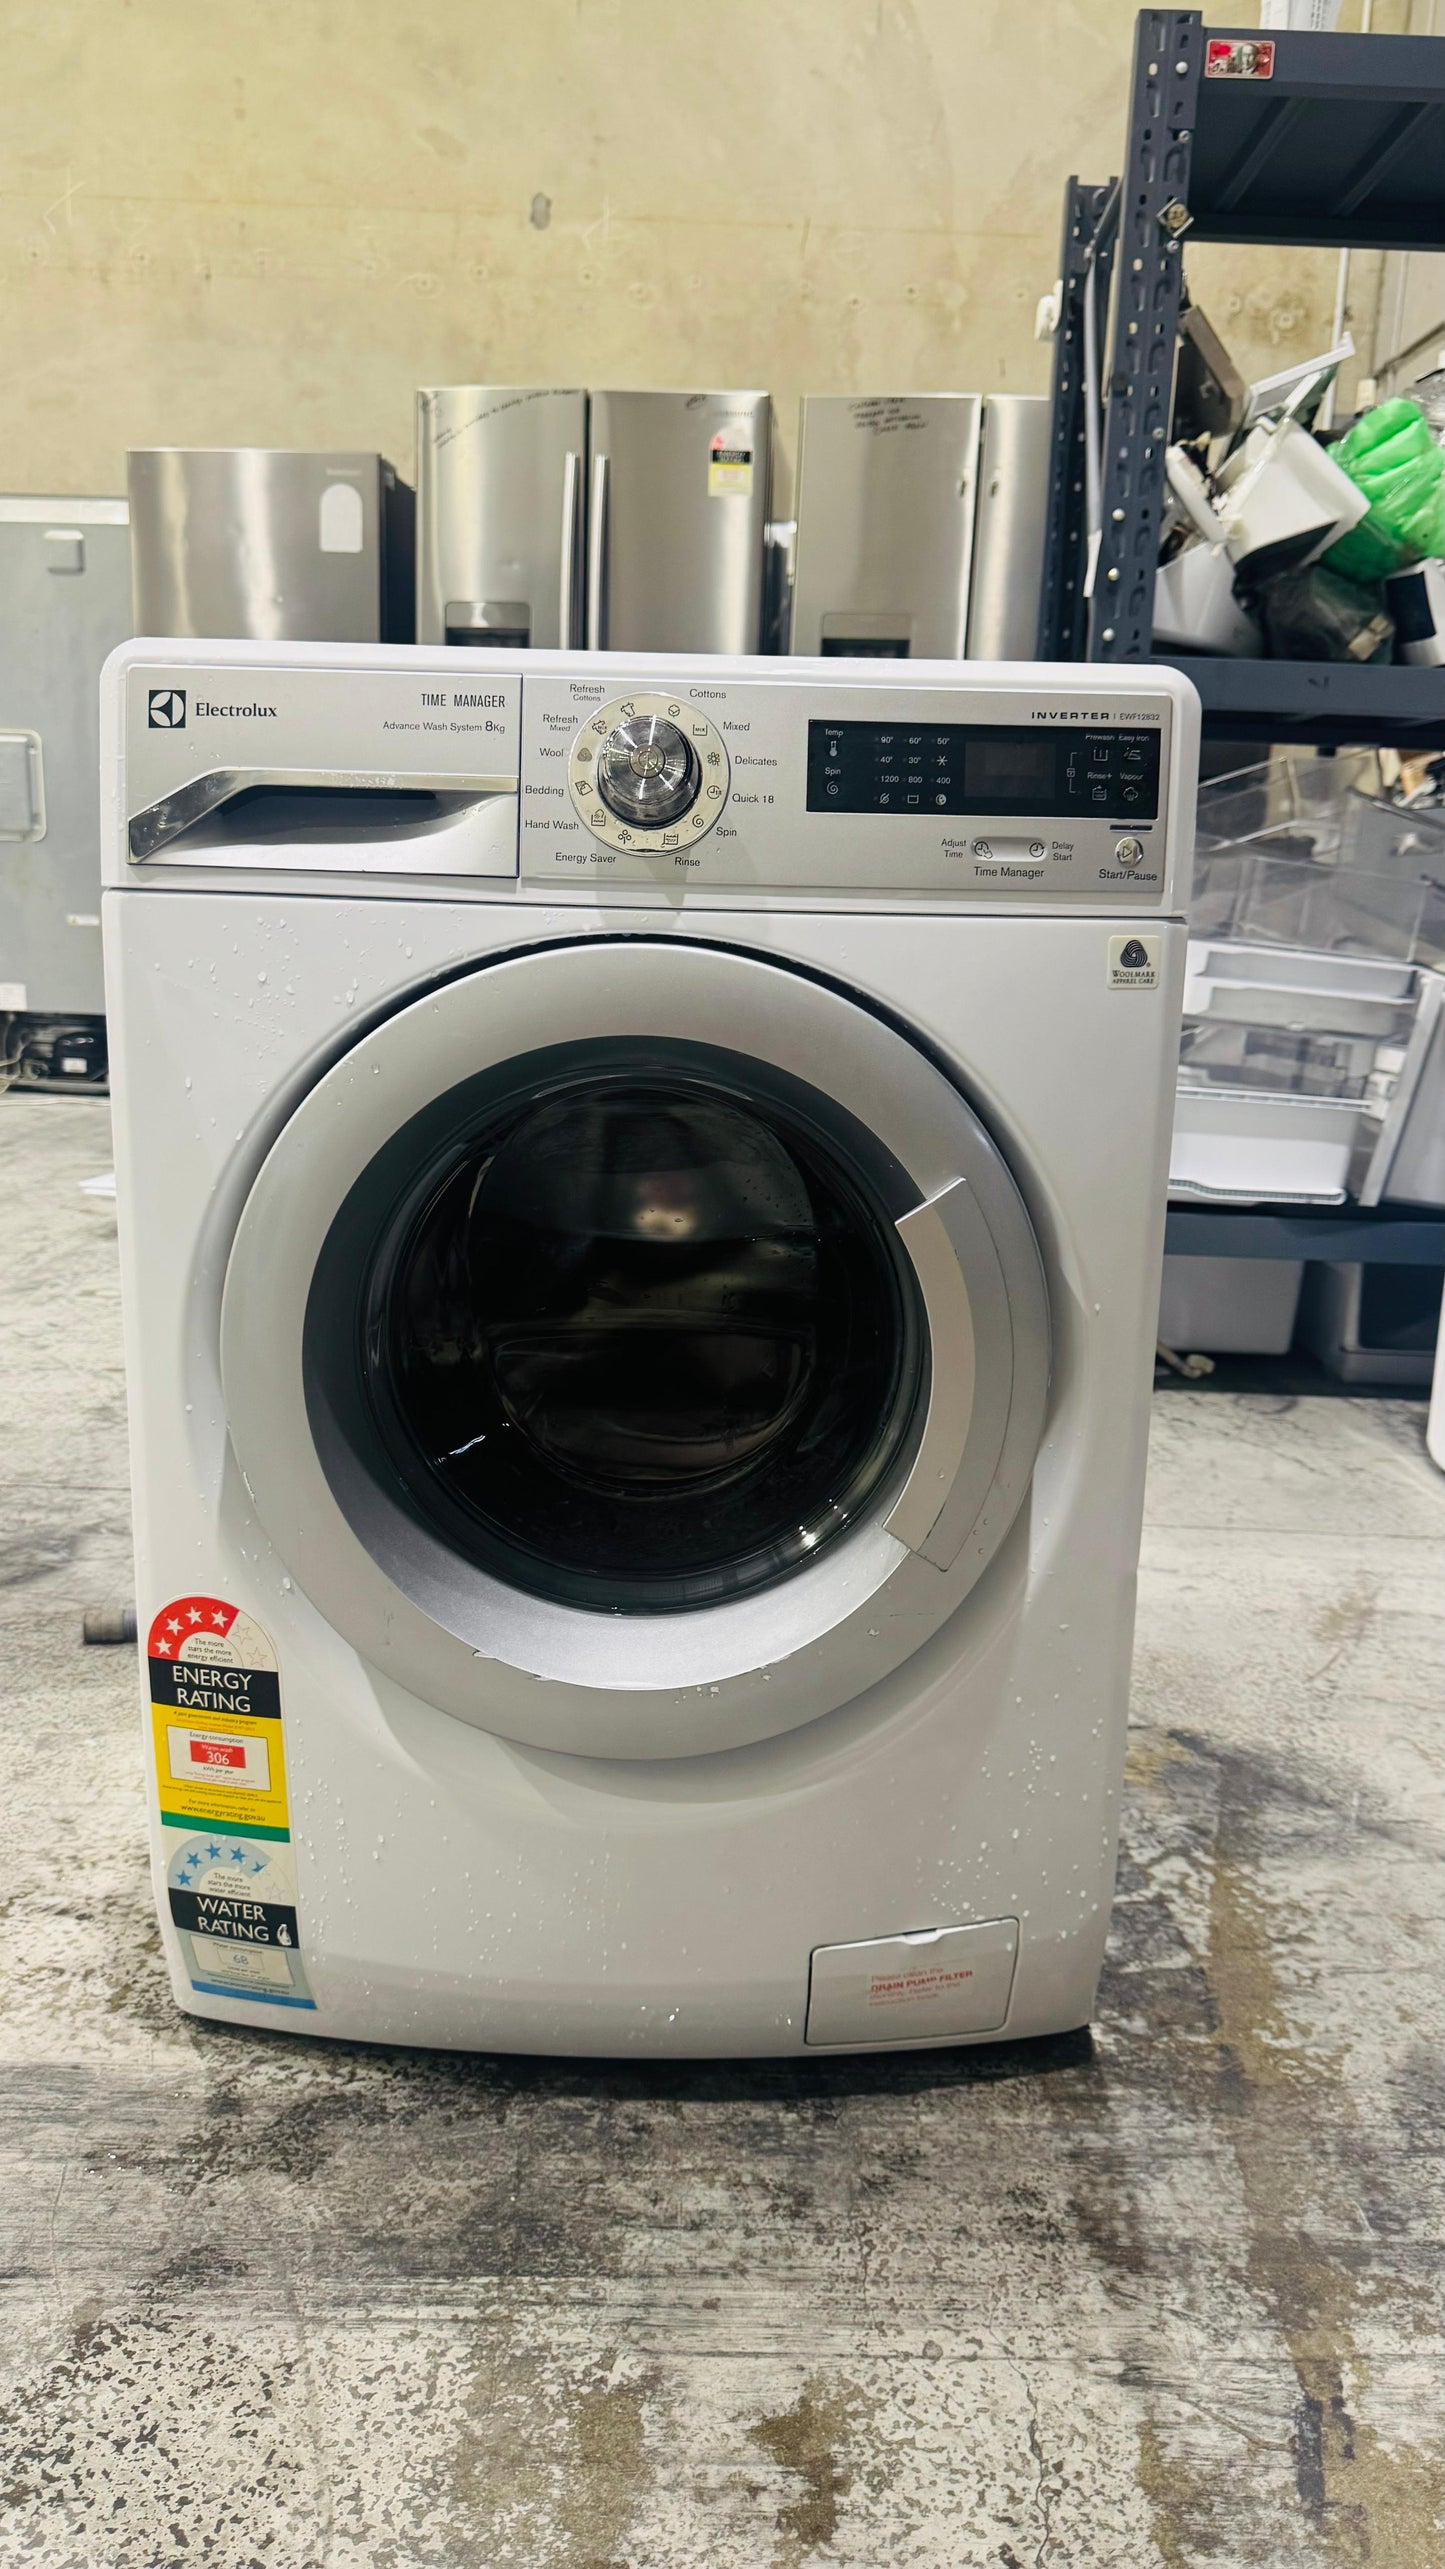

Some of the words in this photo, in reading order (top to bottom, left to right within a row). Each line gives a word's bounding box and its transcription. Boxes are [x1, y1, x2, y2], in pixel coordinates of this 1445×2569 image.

[570, 684, 605, 694] Refresh
[689, 689, 727, 699] Cottons
[421, 694, 447, 707] TIME
[454, 694, 506, 708] MANAGER
[573, 694, 601, 702] Cottons
[195, 702, 278, 718] Electrolux
[543, 714, 579, 724] Refresh
[1032, 712, 1110, 720] INVERTER
[383, 721, 420, 731] Advance
[423, 722, 448, 731] Wash
[450, 723, 482, 734] System
[723, 722, 751, 732] Mixed
[825, 728, 844, 739] Temp
[540, 748, 564, 758] Wool
[735, 755, 778, 767] Delicates
[825, 767, 842, 776] Spin
[908, 776, 923, 784] 800
[936, 777, 951, 785] 400
[525, 785, 565, 798] Bedding
[732, 793, 759, 804] Quick
[763, 796, 775, 804] 18
[525, 820, 550, 830] Hand
[553, 821, 579, 830] Wash
[716, 827, 737, 838] Spin
[941, 838, 967, 849] Adjust
[1052, 841, 1075, 852] Delay
[555, 852, 588, 865] Energy
[590, 853, 617, 863] Saver
[944, 850, 964, 859] Time
[1053, 853, 1073, 861] Start
[675, 857, 701, 867] Rinse
[974, 866, 998, 877] Time
[1000, 867, 1045, 880] Manager
[1098, 868, 1158, 881] Start/Pause
[187, 1654, 208, 1662] energy
[173, 1665, 253, 1691] ENERGY
[177, 1687, 252, 1713] RATING
[189, 1731, 208, 1741] Energy
[209, 1734, 244, 1744] consumption
[206, 1751, 230, 1765] 306
[197, 1896, 267, 1922] WATER
[197, 1916, 270, 1942] RATING
[871, 1981, 904, 1993] DRAIN
[939, 1970, 973, 1982] FILTER
